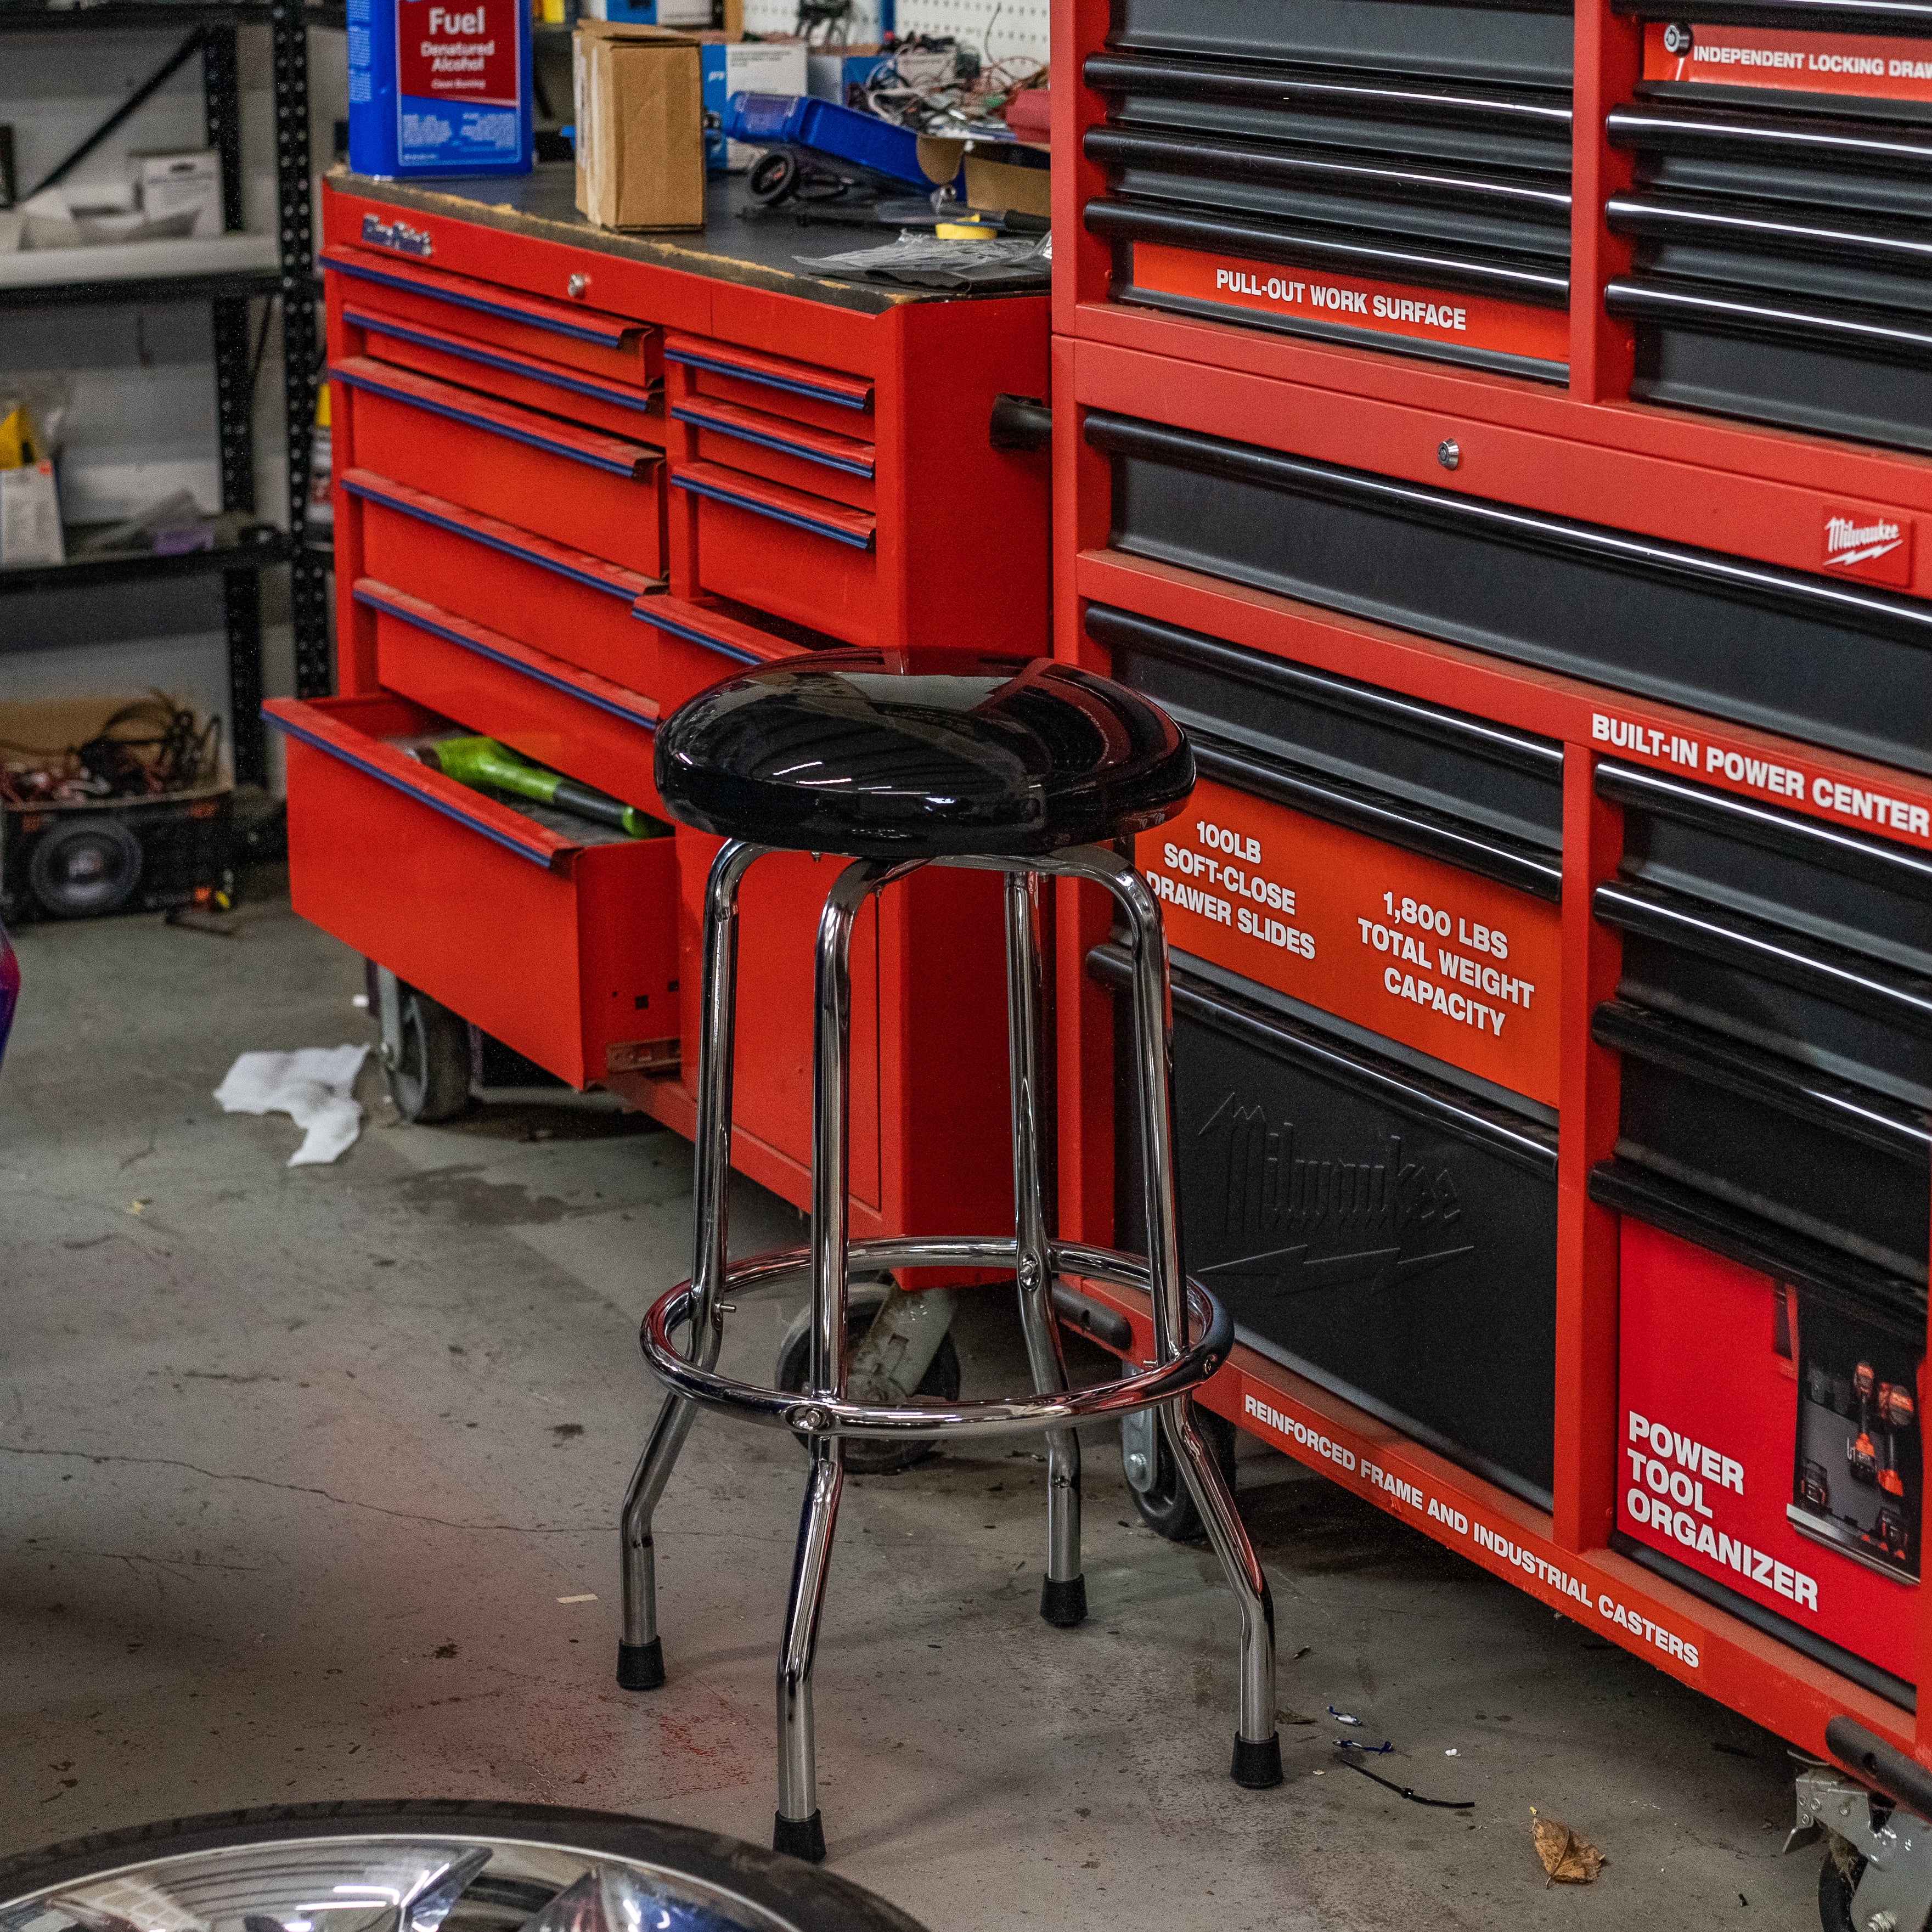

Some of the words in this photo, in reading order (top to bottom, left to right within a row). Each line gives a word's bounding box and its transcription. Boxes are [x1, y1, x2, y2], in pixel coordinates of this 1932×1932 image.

[429, 5, 486, 35] Fuel
[1693, 46, 1805, 69] INDEPENDENT
[1809, 54, 1884, 76] LOCKING
[1216, 269, 1305, 303] PULL-OUT
[1310, 285, 1367, 314] WORK
[1372, 295, 1466, 330] SURFACE
[1592, 713, 1698, 768] BUILT-IN
[1706, 747, 1805, 799] POWER
[1812, 779, 1930, 837] CENTER
[1164, 842, 1295, 915] SOFT-CLOSE
[1197, 821, 1261, 864] 100LB
[1146, 870, 1231, 926] DRAWER
[1237, 908, 1315, 959] SLIDES
[1383, 892, 1450, 937] 1,800
[1459, 919, 1508, 959] LBS
[1358, 917, 1432, 969] TOTAL
[1439, 949, 1535, 1009] WEIGHT
[1384, 967, 1505, 1037] CAPACITY
[1627, 1447, 1713, 1519] TOOL
[1629, 1411, 1744, 1496] POWER
[1245, 1394, 1355, 1471] REINFORCED
[1360, 1458, 1423, 1511] FRAME
[1427, 1497, 1468, 1535] AND
[1474, 1522, 1593, 1608] INDUSTRIAL
[1598, 1595, 1699, 1669] CASTERS
[1627, 1488, 1818, 1613] ORGANIZER
